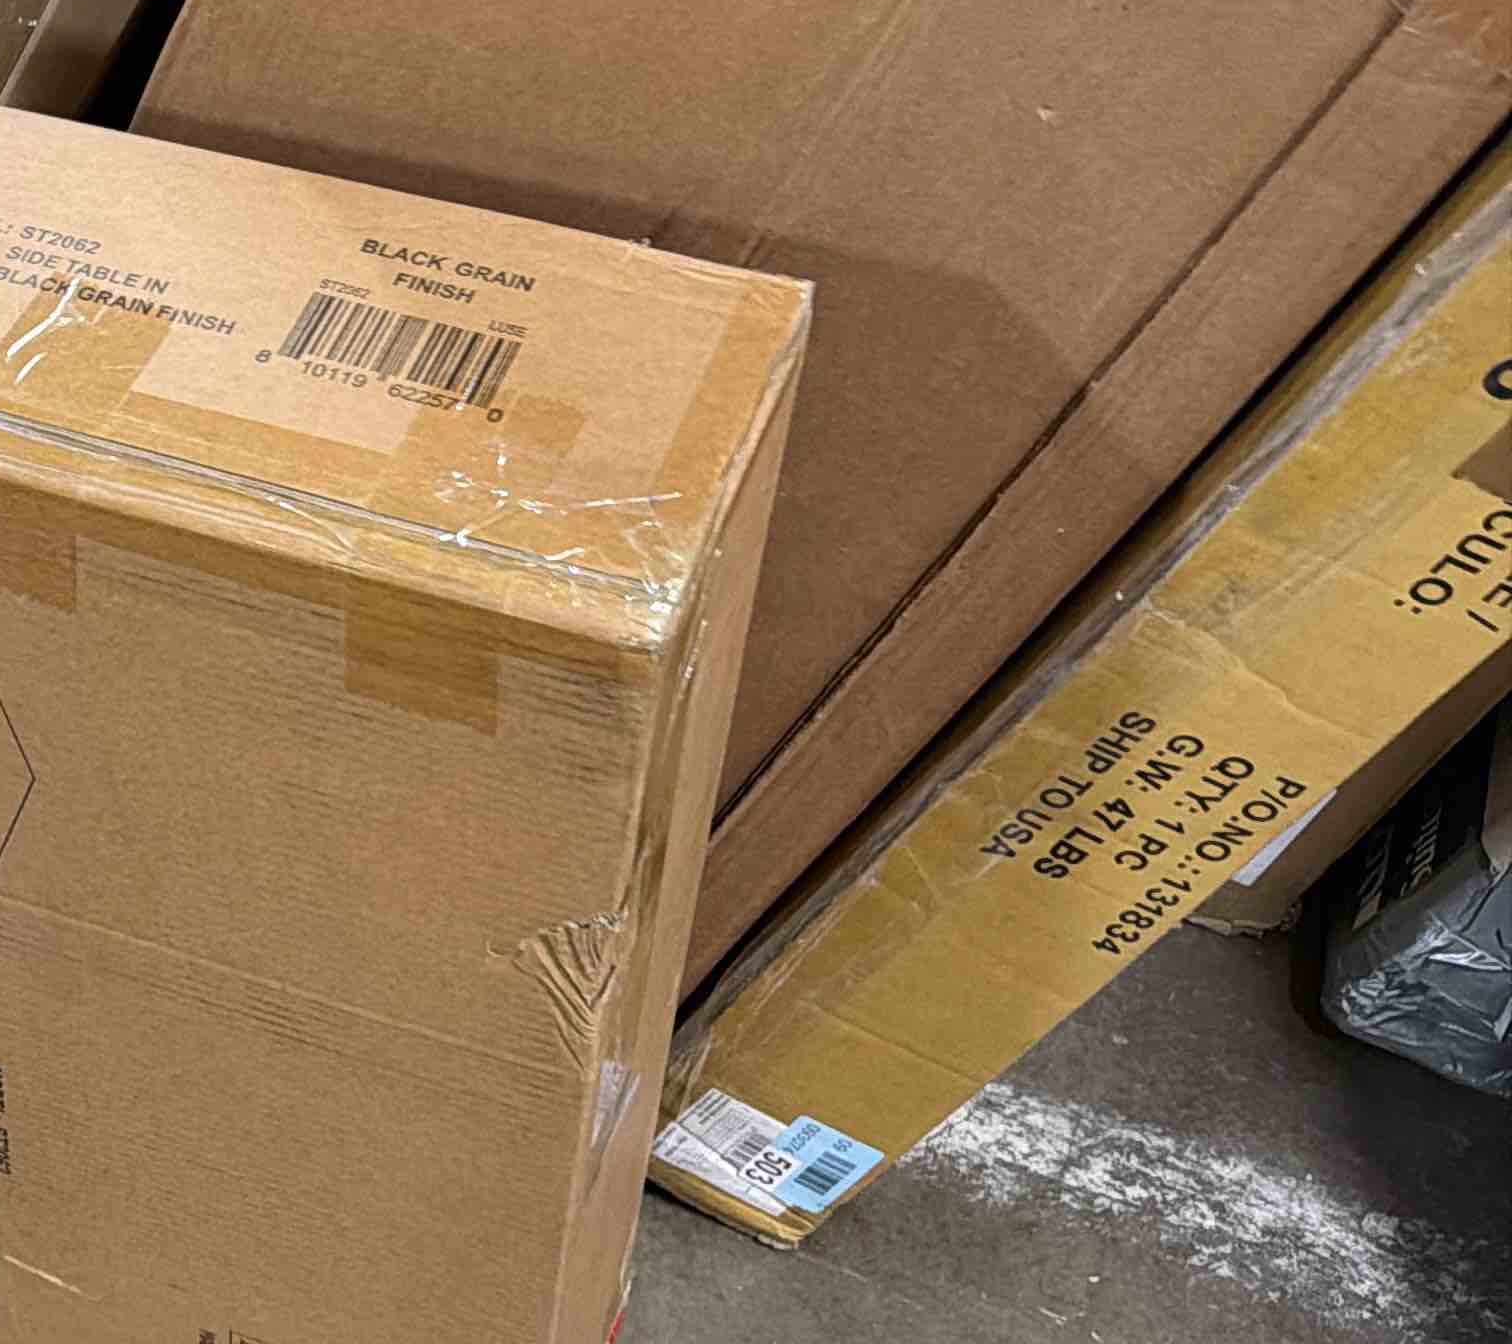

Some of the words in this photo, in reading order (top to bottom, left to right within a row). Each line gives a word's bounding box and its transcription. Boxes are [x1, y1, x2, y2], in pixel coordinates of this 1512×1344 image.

[19, 226, 100, 255] ST2062
[360, 239, 448, 271] BLACK
[455, 262, 536, 292] GRAIN
[7, 245, 66, 272] SIDE
[66, 257, 139, 289] TABLE
[142, 276, 170, 295] IN
[392, 272, 476, 304] FINISH
[76, 284, 156, 317] GRAIN
[156, 302, 237, 336] FINISH
[255, 349, 272, 364] 8
[303, 360, 368, 388] 10119
[388, 384, 458, 411] 62257
[486, 408, 505, 423] 0
[1076, 711, 1156, 775] SHIP
[1040, 776, 1092, 810] TO
[1174, 756, 1256, 815] QTY:
[979, 808, 1047, 860] USA
[1093, 796, 1138, 830] 47
[1155, 812, 1187, 835] 1
[1032, 826, 1103, 879] LBS
[1113, 832, 1167, 874] PC
[1091, 872, 1190, 956] 131834
[745, 1150, 793, 1185] 503
